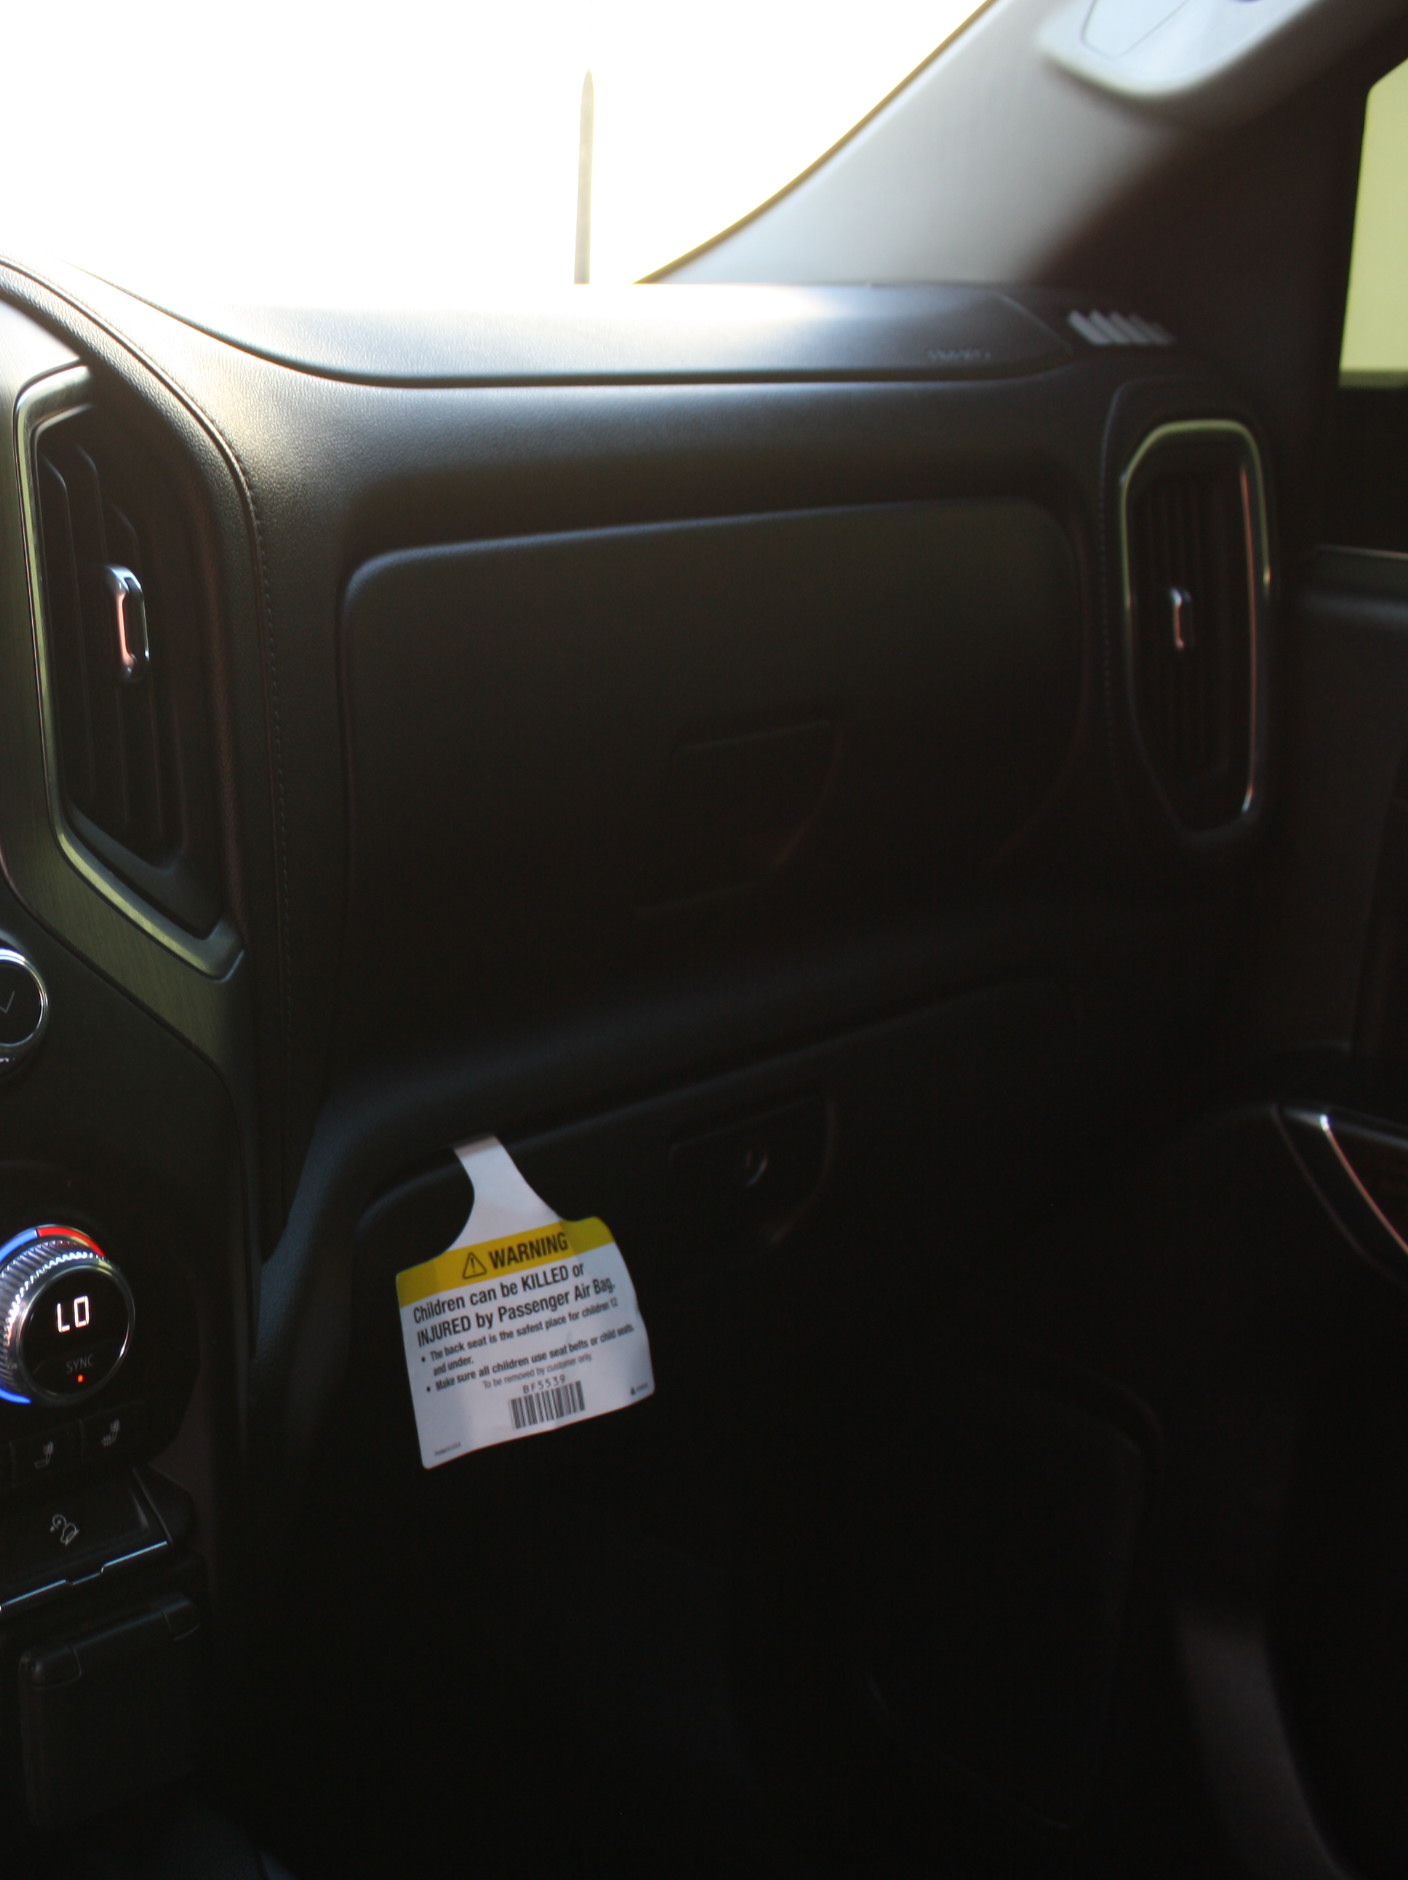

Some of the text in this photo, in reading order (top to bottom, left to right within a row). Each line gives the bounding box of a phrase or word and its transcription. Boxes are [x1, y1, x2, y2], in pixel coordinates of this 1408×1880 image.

[489, 1232, 568, 1269] WARNING
[55, 1294, 90, 1334] LO
[413, 1263, 585, 1324] Children can be KILLED or
[417, 1278, 615, 1347] INJURED by Passenger Air Bag.
[430, 1349, 443, 1361] The
[444, 1342, 466, 1357] back
[467, 1336, 487, 1350] seat
[489, 1333, 497, 1344] is
[499, 1329, 514, 1341] the
[516, 1321, 544, 1338] safest
[545, 1315, 567, 1331] place
[568, 1310, 580, 1322] for
[582, 1301, 610, 1318] children
[66, 1354, 93, 1375] SYNC
[433, 1356, 474, 1377] and under.
[435, 1377, 455, 1392] Make
[456, 1370, 477, 1384] sure
[478, 1365, 490, 1377] all
[492, 1357, 529, 1374] children
[531, 1352, 547, 1363] use
[549, 1345, 567, 1359] seat
[568, 1339, 589, 1353] belts
[590, 1337, 598, 1346] or
[599, 1329, 616, 1343] child
